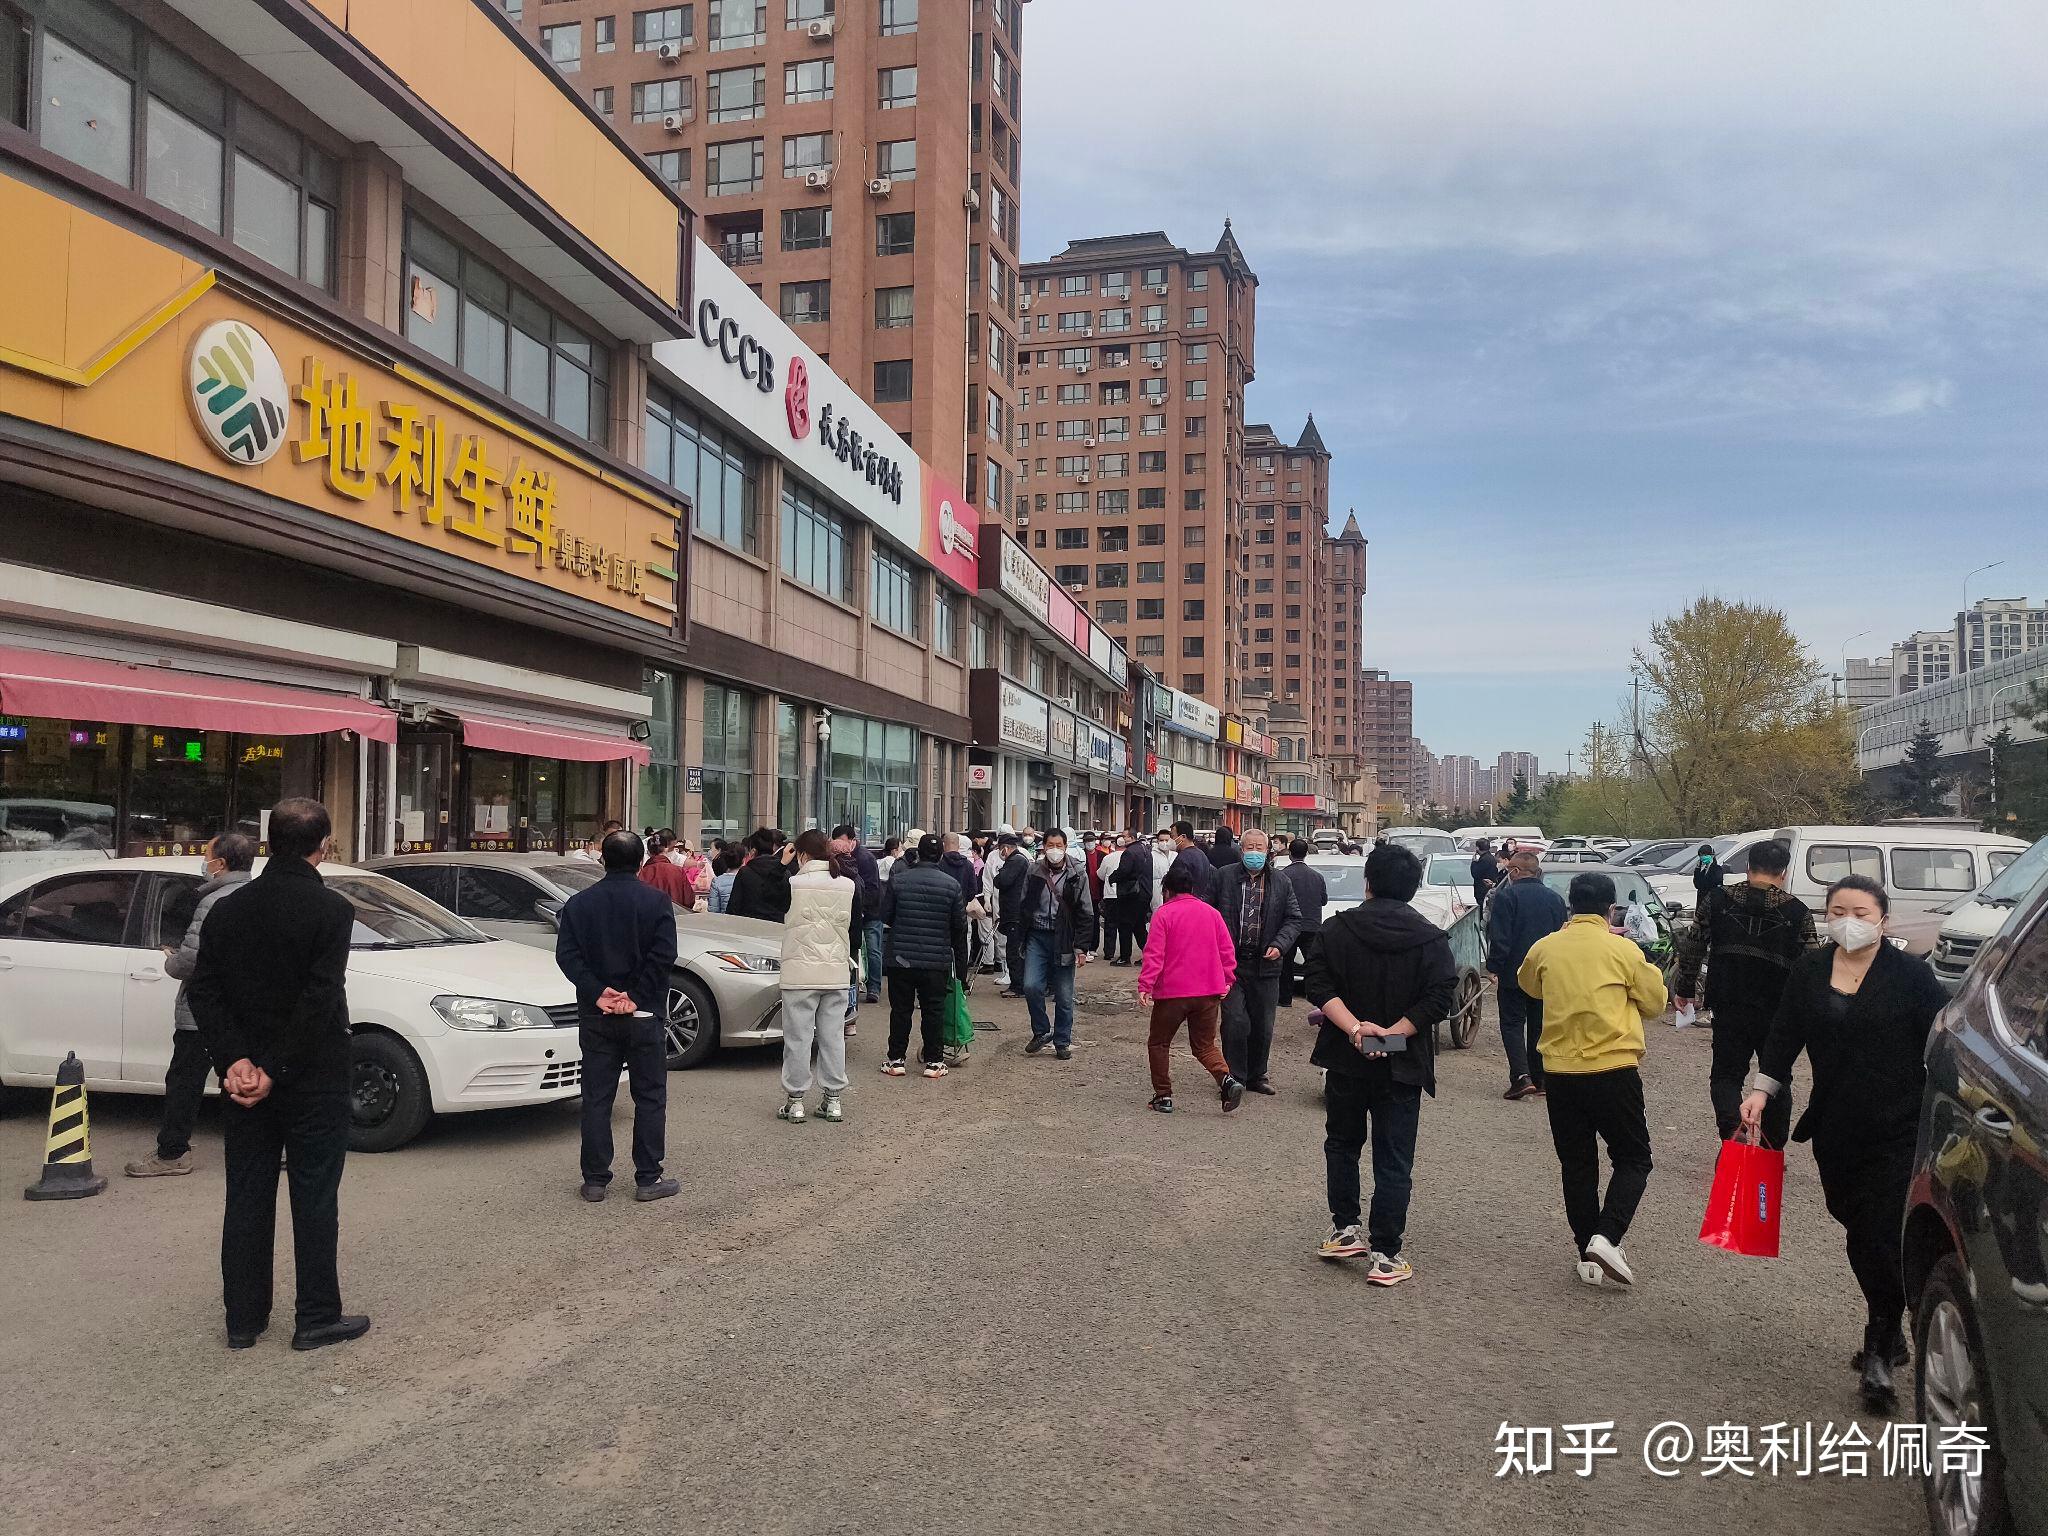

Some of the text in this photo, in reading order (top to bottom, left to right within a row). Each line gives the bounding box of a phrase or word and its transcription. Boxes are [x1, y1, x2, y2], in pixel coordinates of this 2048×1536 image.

[699, 299, 775, 393] CCCB
[291, 355, 558, 568] 地利生鲜
